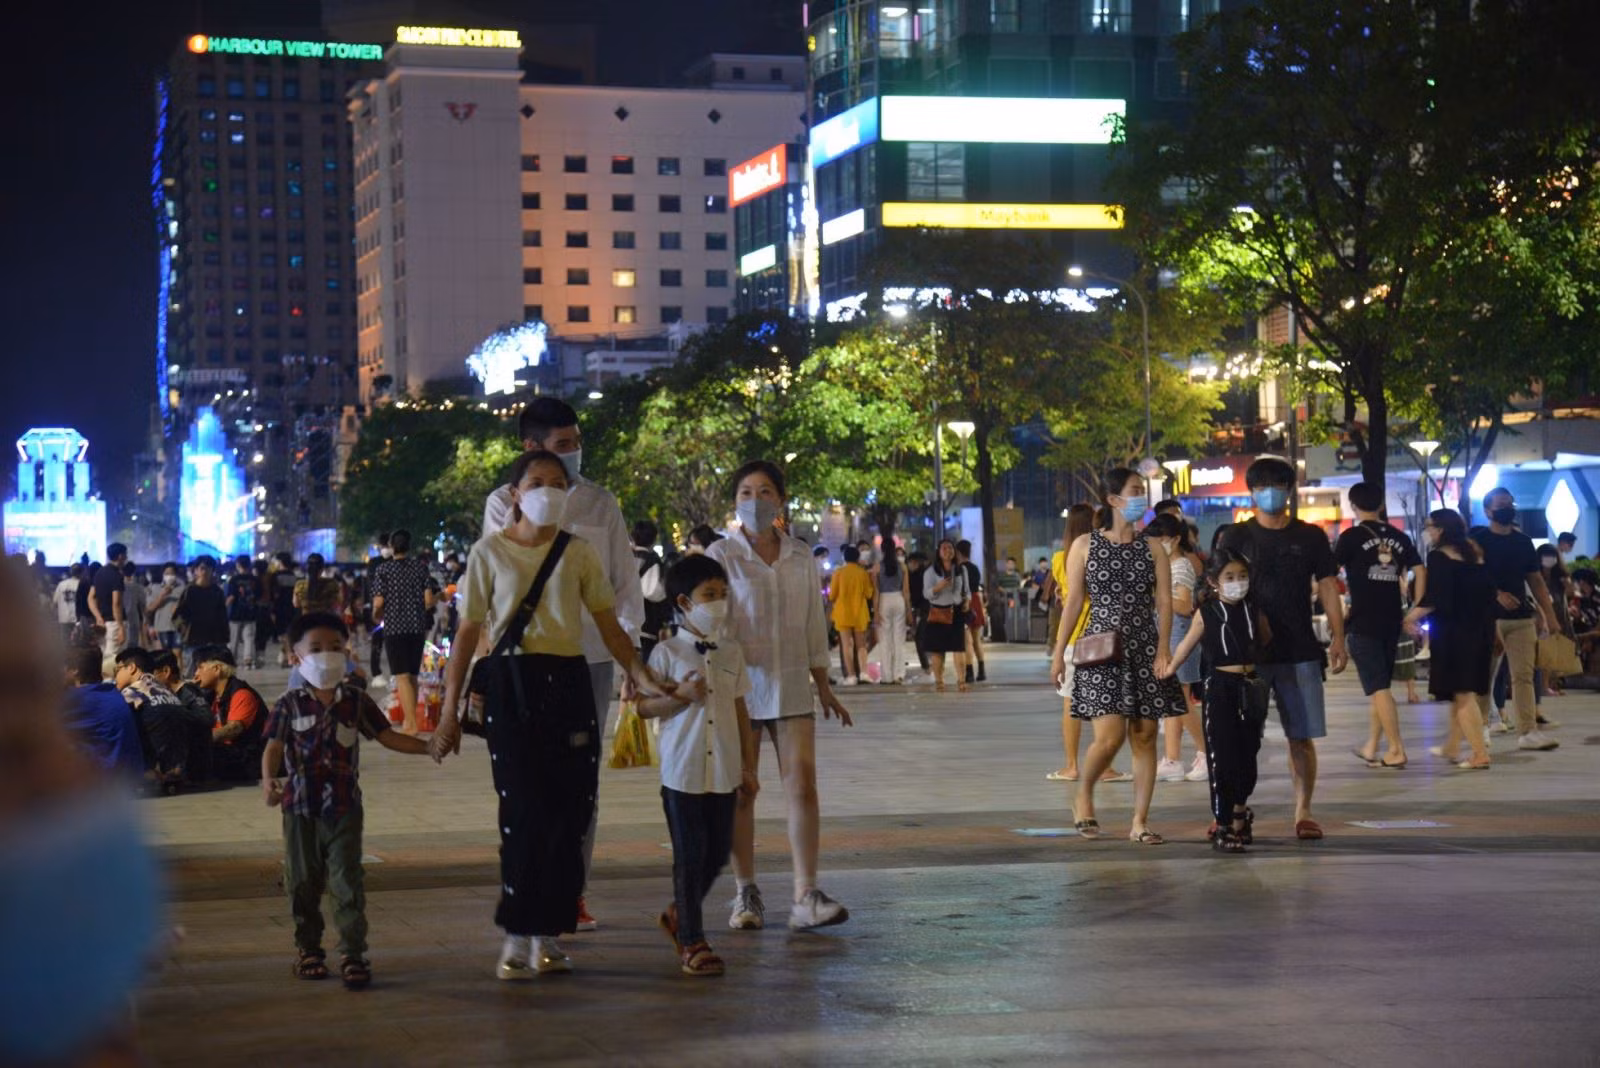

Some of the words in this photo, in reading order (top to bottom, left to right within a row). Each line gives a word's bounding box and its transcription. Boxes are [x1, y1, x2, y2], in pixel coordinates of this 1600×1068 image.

[208, 37, 283, 55] HARBOUR
[285, 41, 325, 57] VIEW
[326, 42, 383, 60] TOWER
[1361, 538, 1381, 551] NEW
[1383, 537, 1404, 554] YORK
